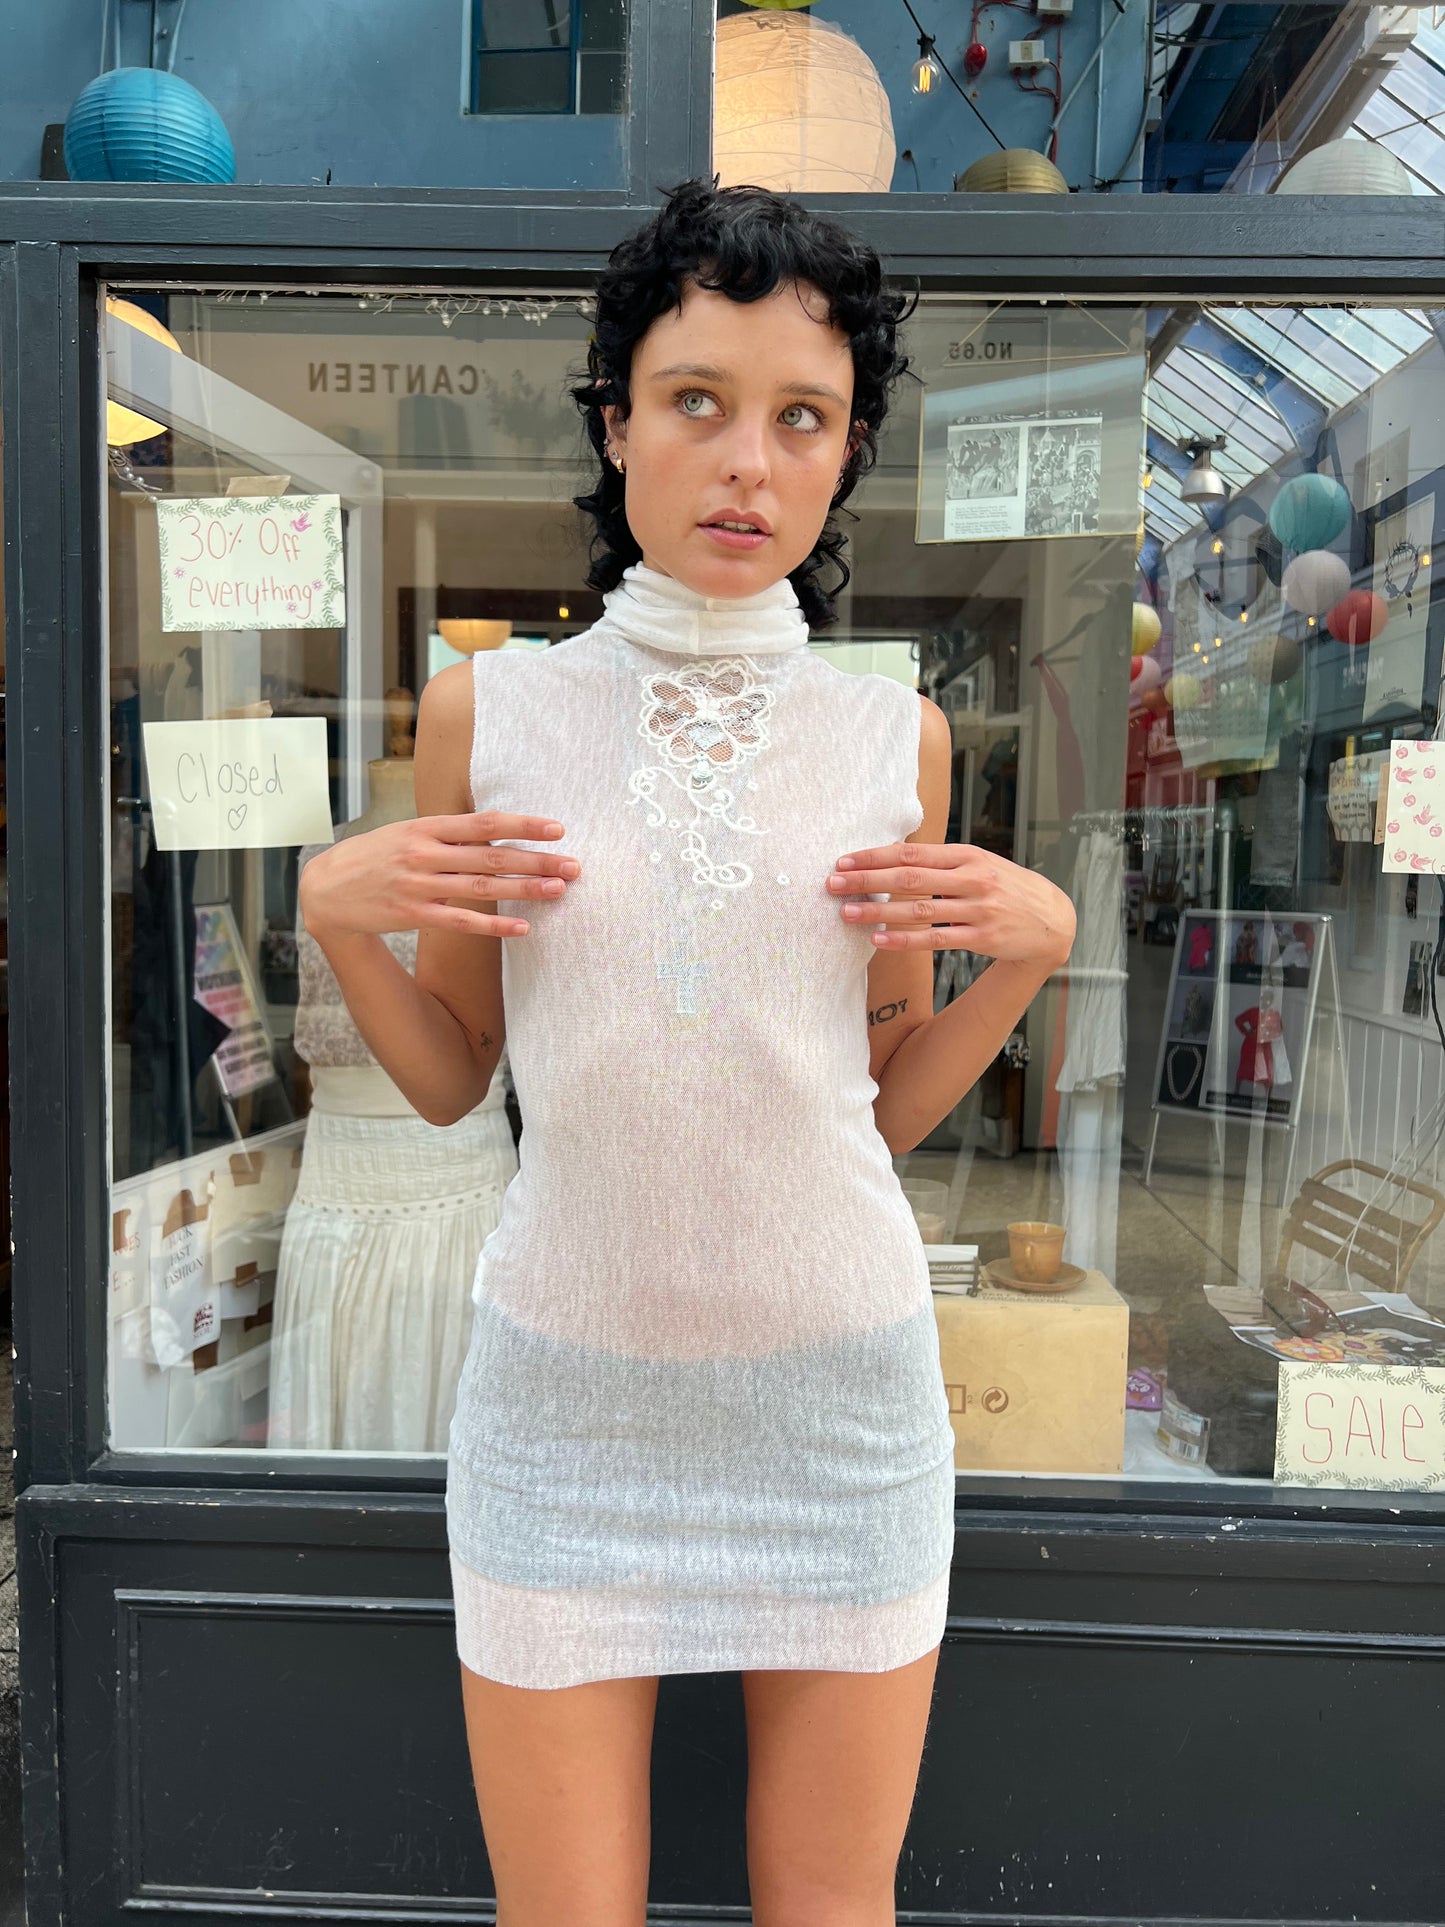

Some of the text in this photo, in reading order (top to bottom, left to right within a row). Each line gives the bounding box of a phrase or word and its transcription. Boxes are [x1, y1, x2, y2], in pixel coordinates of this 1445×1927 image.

[179, 515, 301, 563] 30% Off
[189, 576, 312, 620] everything
[177, 752, 283, 803] Closed
